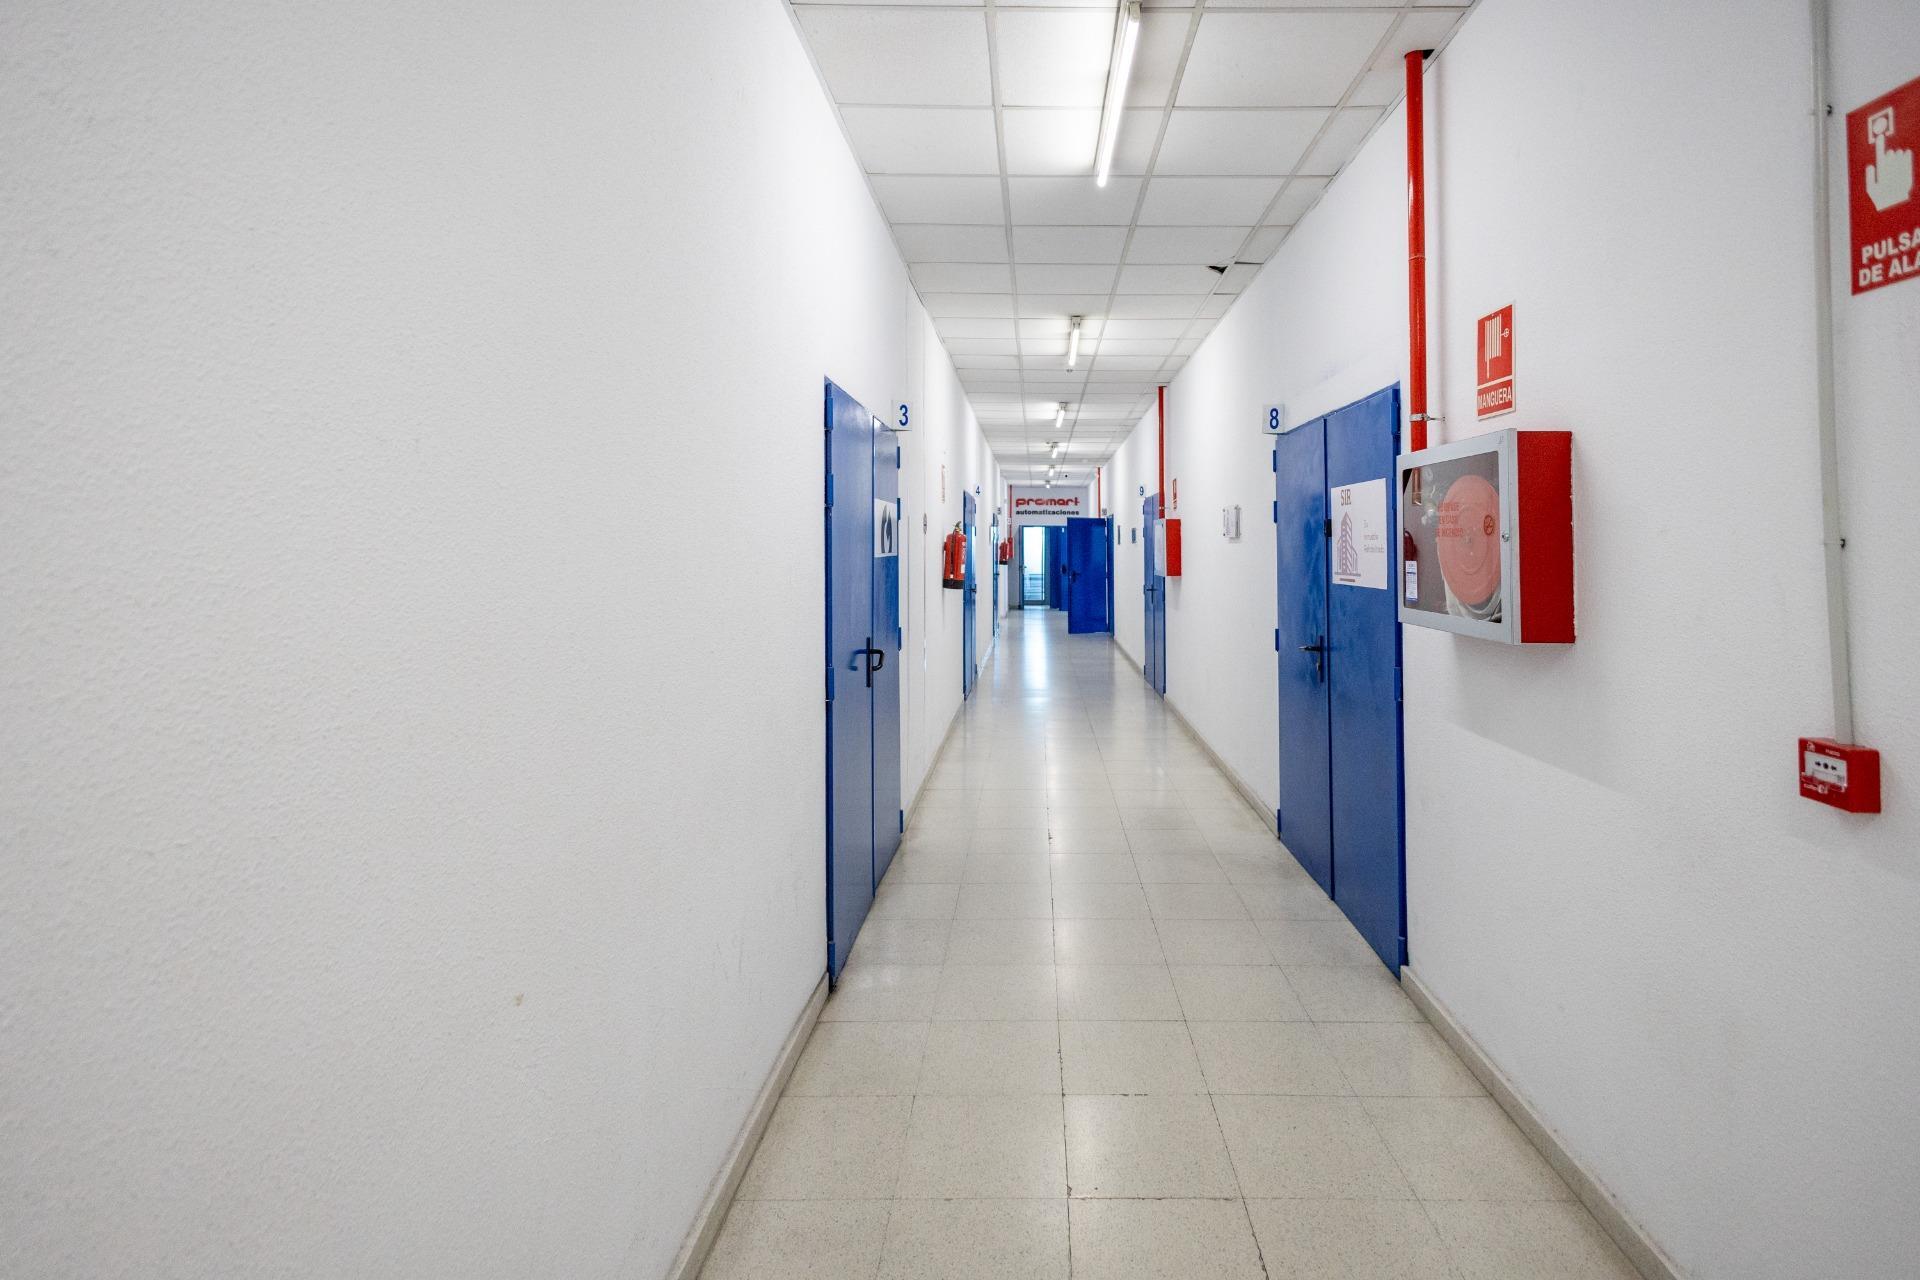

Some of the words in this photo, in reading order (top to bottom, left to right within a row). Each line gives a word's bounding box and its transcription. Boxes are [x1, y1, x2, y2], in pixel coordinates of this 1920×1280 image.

[1858, 263, 1883, 286] DE
[1477, 386, 1512, 410] MANGUERA
[898, 405, 909, 427] 3
[1269, 407, 1280, 430] 8
[976, 486, 981, 496] 4
[1139, 486, 1145, 496] 9
[1340, 488, 1352, 506] SIR
[1016, 496, 1080, 508] promart
